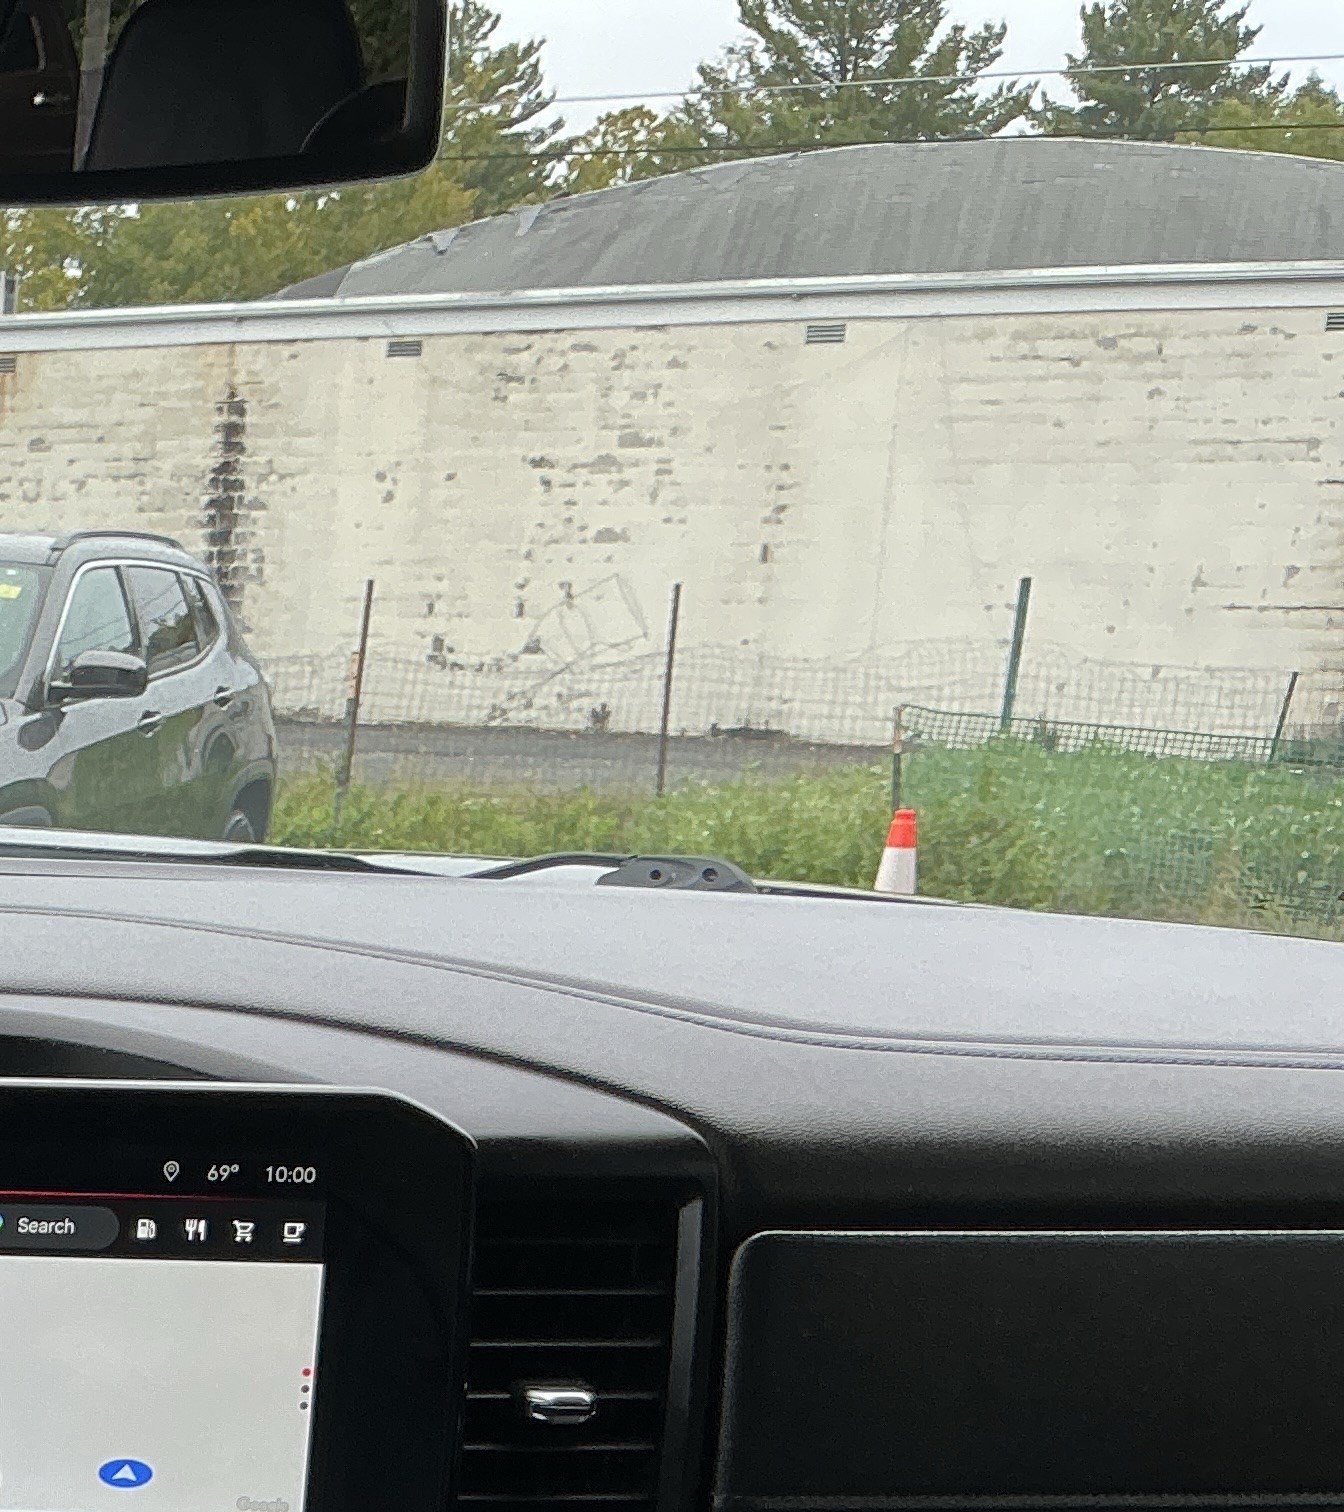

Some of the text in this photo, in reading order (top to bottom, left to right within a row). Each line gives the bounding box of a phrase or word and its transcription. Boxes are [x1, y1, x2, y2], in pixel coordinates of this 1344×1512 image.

[207, 1165, 240, 1181] 69°
[265, 1166, 316, 1182] 10:00
[18, 1217, 75, 1234] Search
